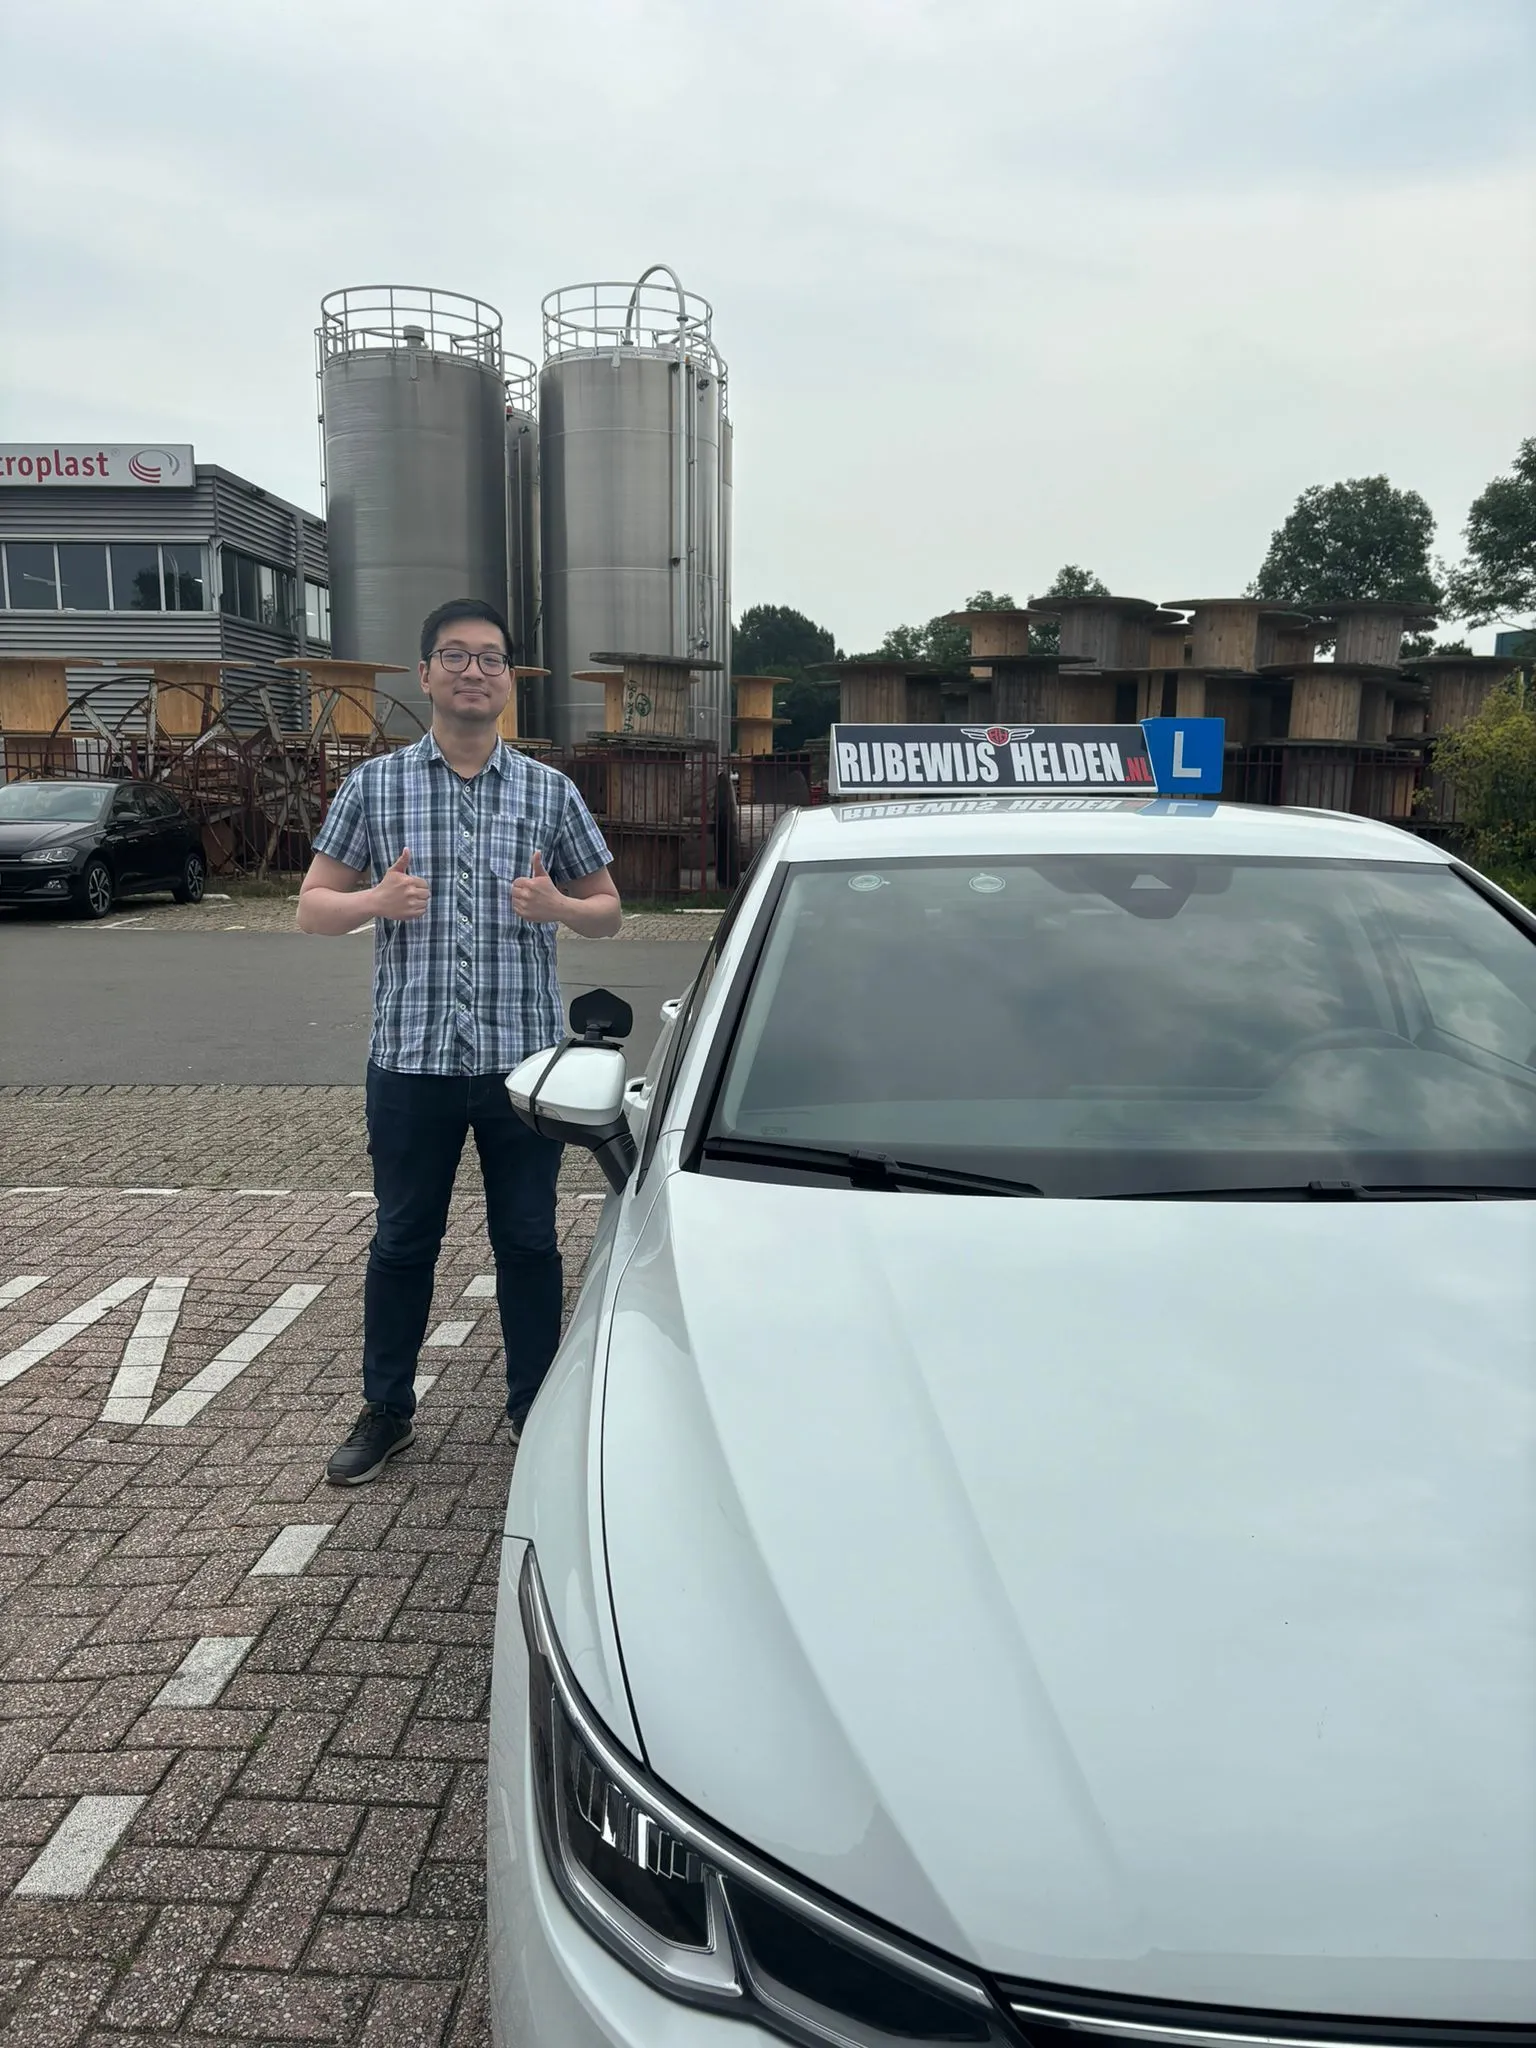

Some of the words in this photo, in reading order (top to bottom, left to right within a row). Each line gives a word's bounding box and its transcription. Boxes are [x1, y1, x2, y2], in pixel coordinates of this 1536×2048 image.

[0, 449, 110, 483] roplast
[837, 742, 1000, 782] RIJBEWIJS
[1172, 730, 1202, 778] L
